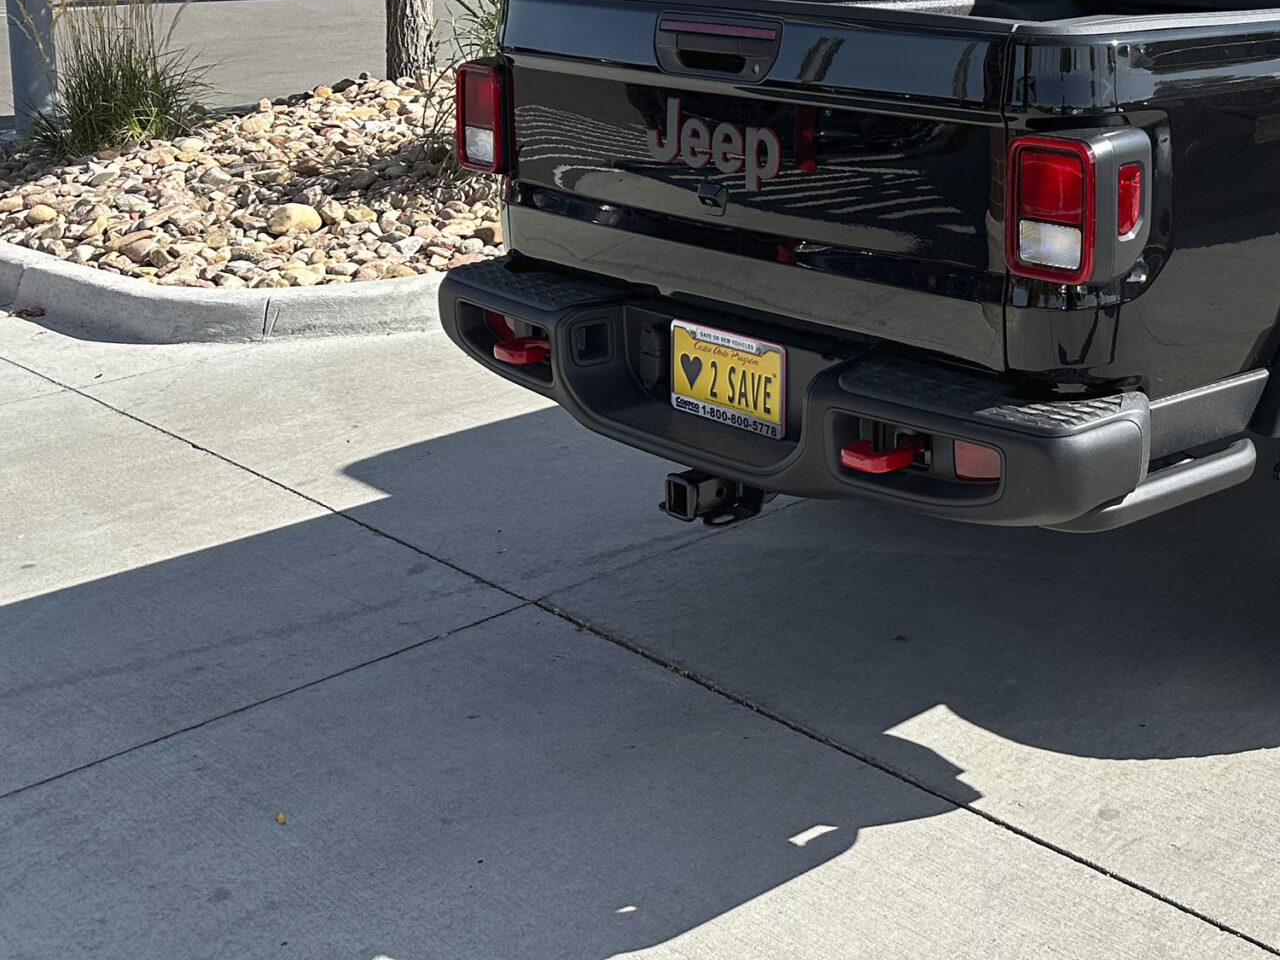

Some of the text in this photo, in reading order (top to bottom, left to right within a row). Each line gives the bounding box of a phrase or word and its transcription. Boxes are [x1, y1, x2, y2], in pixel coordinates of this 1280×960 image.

[646, 96, 781, 192] Jeep
[700, 331, 712, 339] SAVE
[720, 336, 730, 344] NEW
[731, 339, 754, 351] VEHICLES
[731, 350, 759, 366] Program
[709, 360, 718, 398] 2
[675, 396, 700, 409] COSTCO
[701, 404, 777, 436] 1-800-800-5778
